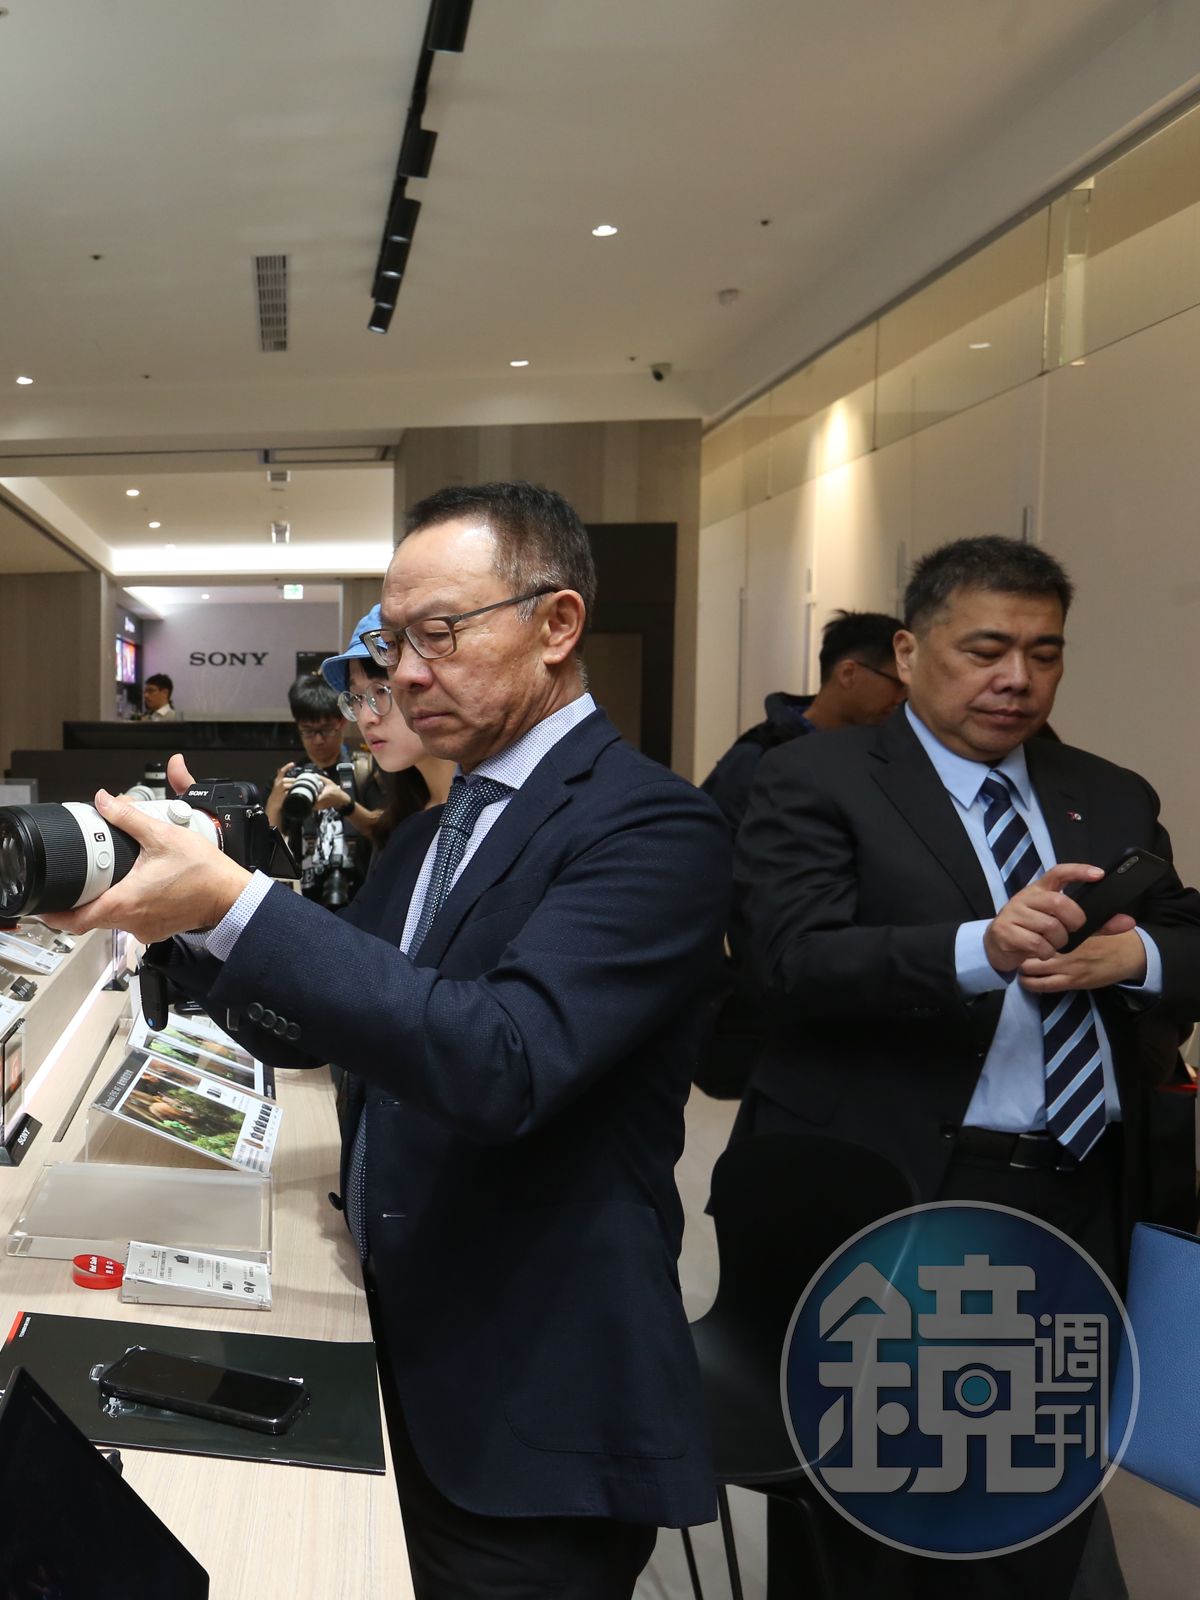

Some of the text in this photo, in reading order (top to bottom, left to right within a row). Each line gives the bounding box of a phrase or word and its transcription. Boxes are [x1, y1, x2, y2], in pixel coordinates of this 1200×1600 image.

[189, 651, 269, 667] SONY
[187, 789, 210, 797] SONY
[94, 832, 106, 842] G
[16, 1126, 32, 1146] SONY
